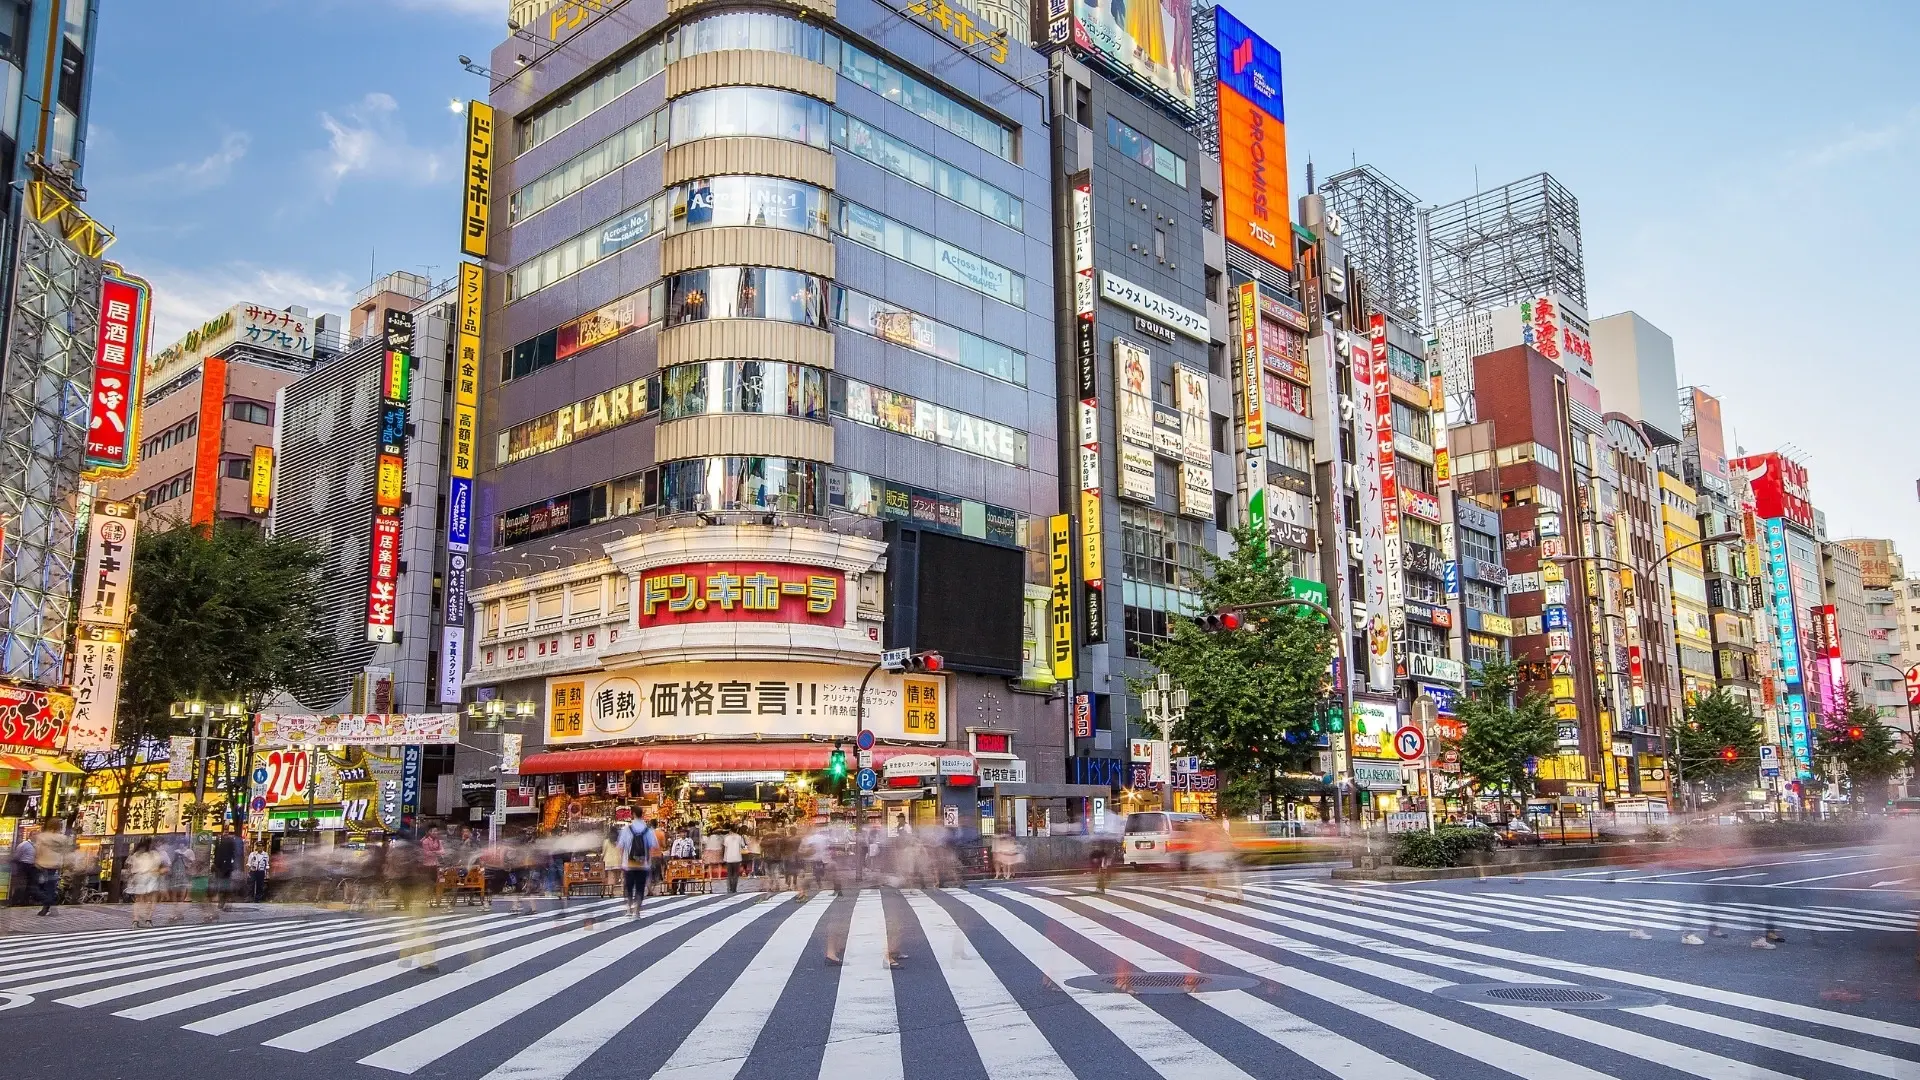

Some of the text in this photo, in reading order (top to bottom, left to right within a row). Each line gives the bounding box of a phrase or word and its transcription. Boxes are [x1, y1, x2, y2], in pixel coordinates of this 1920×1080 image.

[1249, 108, 1268, 222] PROMISE
[1248, 221, 1276, 248] プロミス
[967, 272, 998, 292] TRAVEL
[980, 261, 1003, 283] No.1
[465, 269, 479, 332] ブランド品
[102, 299, 130, 365] 居酒屋
[243, 324, 313, 351] カプセル
[1140, 320, 1176, 341] SQUARE
[461, 346, 475, 393] 貴金属
[90, 377, 124, 433] つぼ八
[556, 379, 646, 439] FLARE
[456, 413, 472, 470] 高額買取
[892, 422, 935, 441] STUDIO
[915, 399, 1014, 456] FLARE
[509, 433, 572, 463] PHOTO STUDIO
[105, 506, 129, 517] 6F
[382, 507, 395, 516] 6F
[886, 489, 909, 510] 販売
[1087, 500, 1096, 569] アラビアンロック
[97, 540, 123, 608] ヤキトリ
[1446, 562, 1456, 593] 747
[1090, 593, 1099, 637] ミステリアス
[91, 629, 117, 641] 5F
[448, 641, 458, 684] 写真スタジオ
[597, 687, 636, 720] 情熱
[1075, 704, 1088, 737] ダイコク
[1762, 748, 1772, 759] P
[266, 752, 307, 804] 270
[339, 768, 365, 781] カラオケ
[404, 748, 418, 803] カラオケ
[341, 799, 369, 821] 747
[384, 780, 397, 825] カラオケ
[403, 805, 415, 813] B1
[1095, 801, 1102, 814] P
